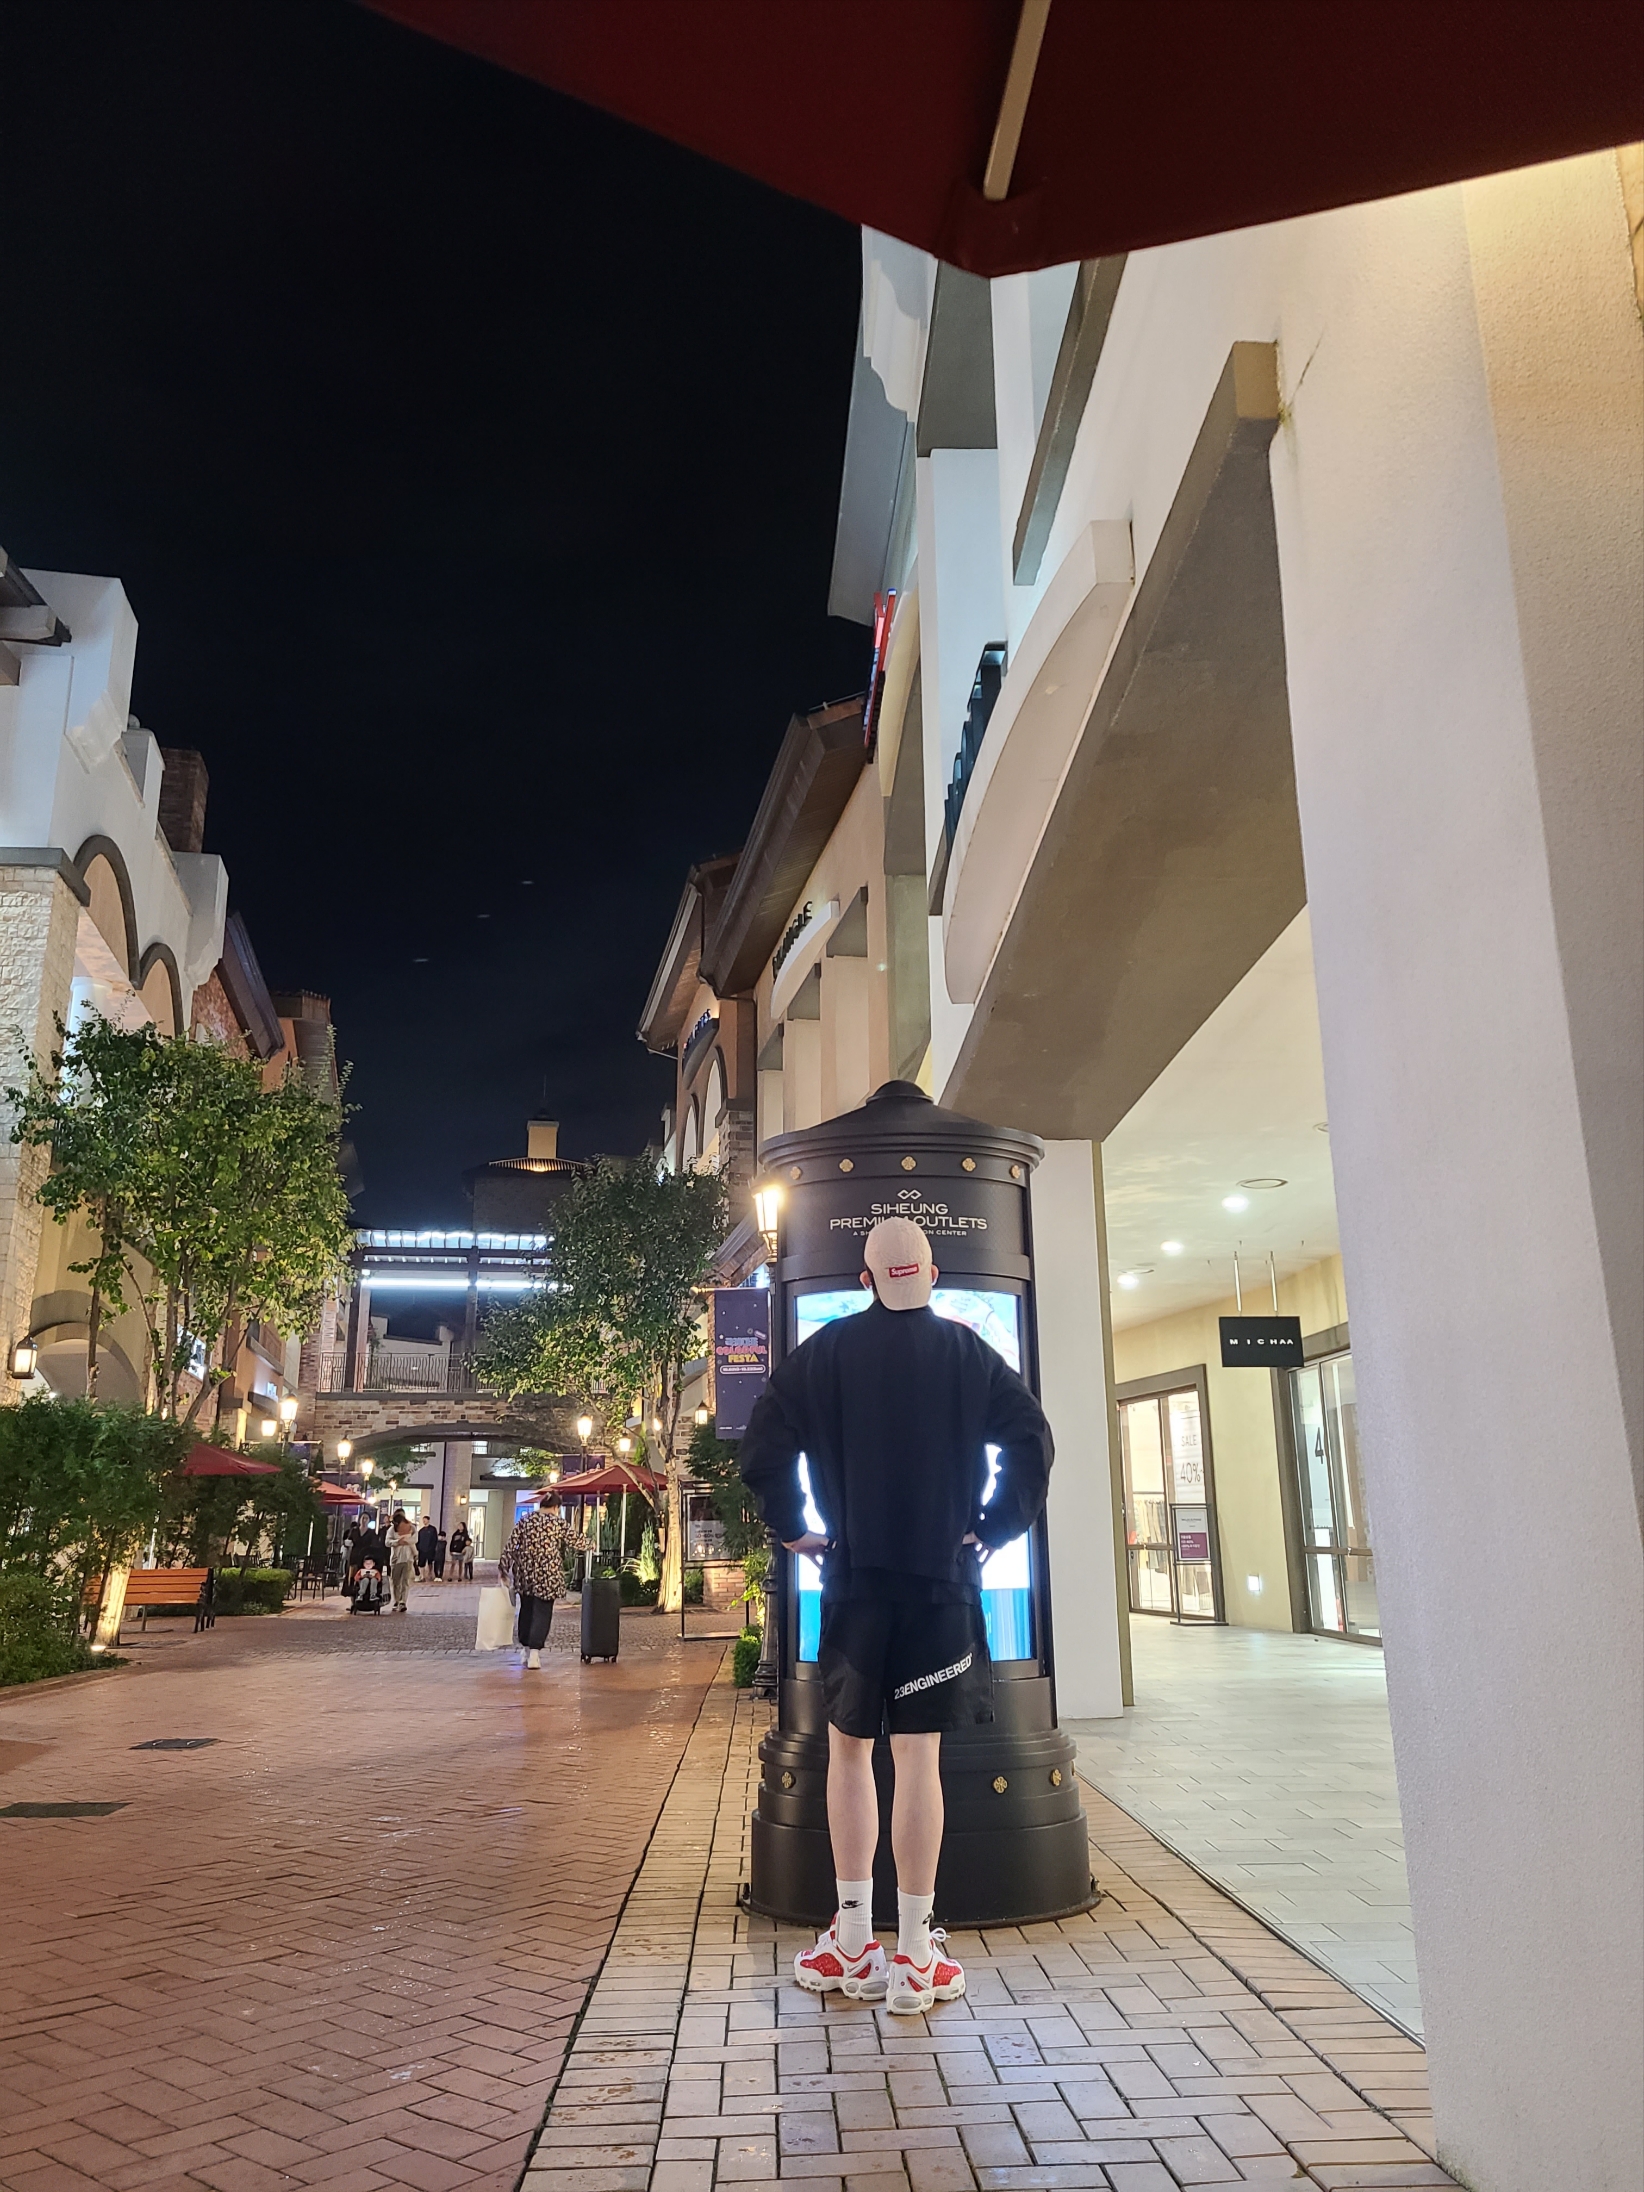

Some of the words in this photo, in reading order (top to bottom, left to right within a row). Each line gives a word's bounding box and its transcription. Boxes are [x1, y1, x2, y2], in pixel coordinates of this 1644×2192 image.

[870, 1203, 949, 1215] SIHEUNG
[829, 1216, 909, 1230] PREMI
[912, 1215, 988, 1230] OUTLETS
[935, 1229, 968, 1237] CENTER
[891, 1266, 918, 1277] Supreme
[728, 1354, 759, 1363] FESTA
[1181, 1434, 1198, 1447] SALE
